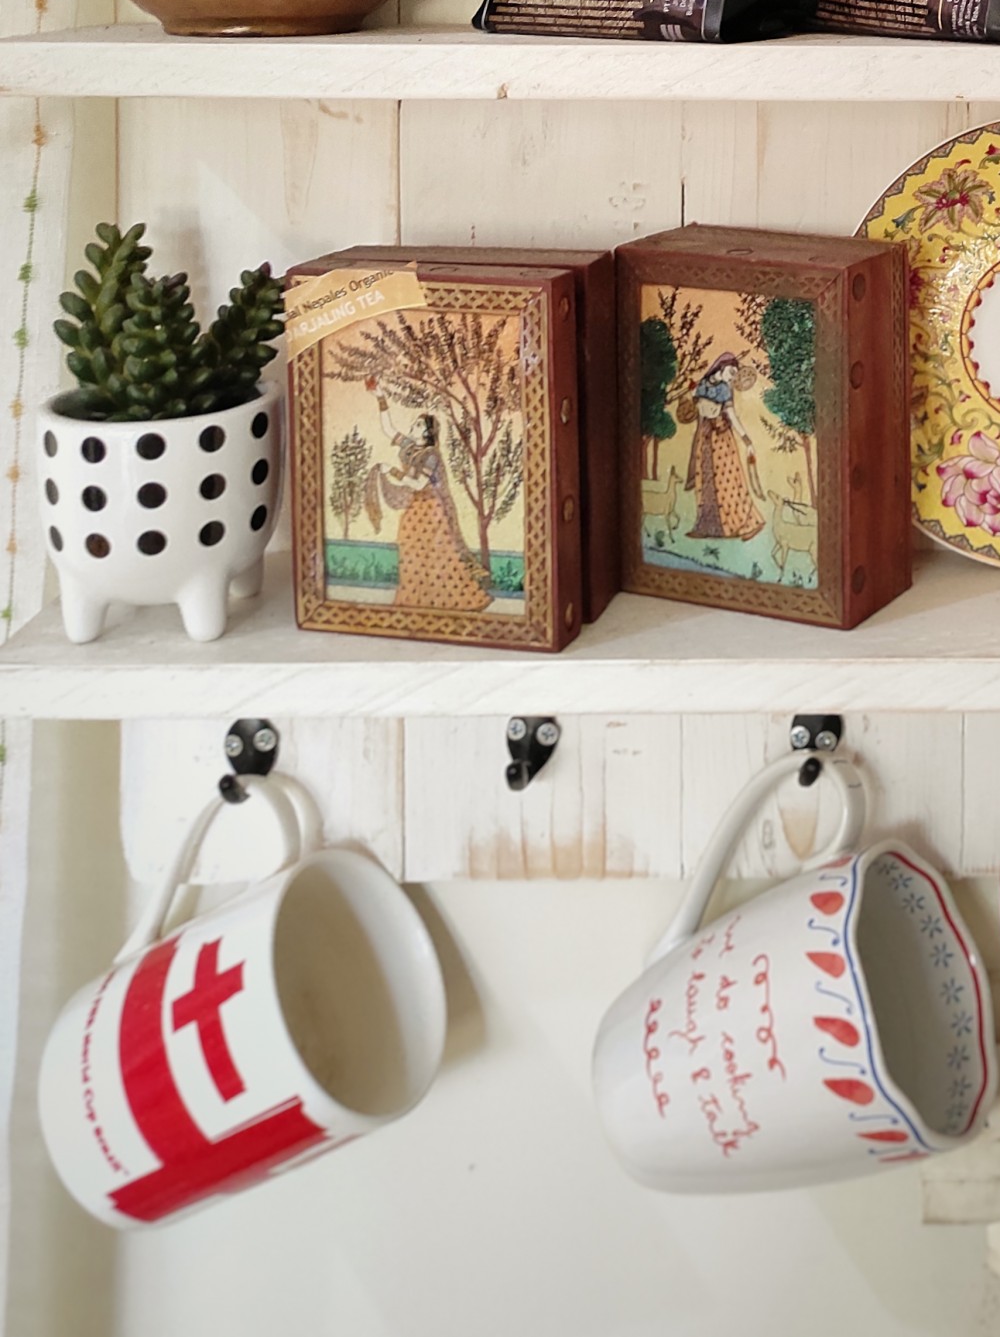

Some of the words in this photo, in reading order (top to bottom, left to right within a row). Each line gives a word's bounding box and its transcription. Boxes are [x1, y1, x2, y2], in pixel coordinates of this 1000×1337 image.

[302, 286, 347, 314] Nepales
[357, 289, 385, 311] TEA
[668, 967, 702, 1054] laugh
[698, 1095, 741, 1159] talk
[721, 1031, 761, 1139] cooking
